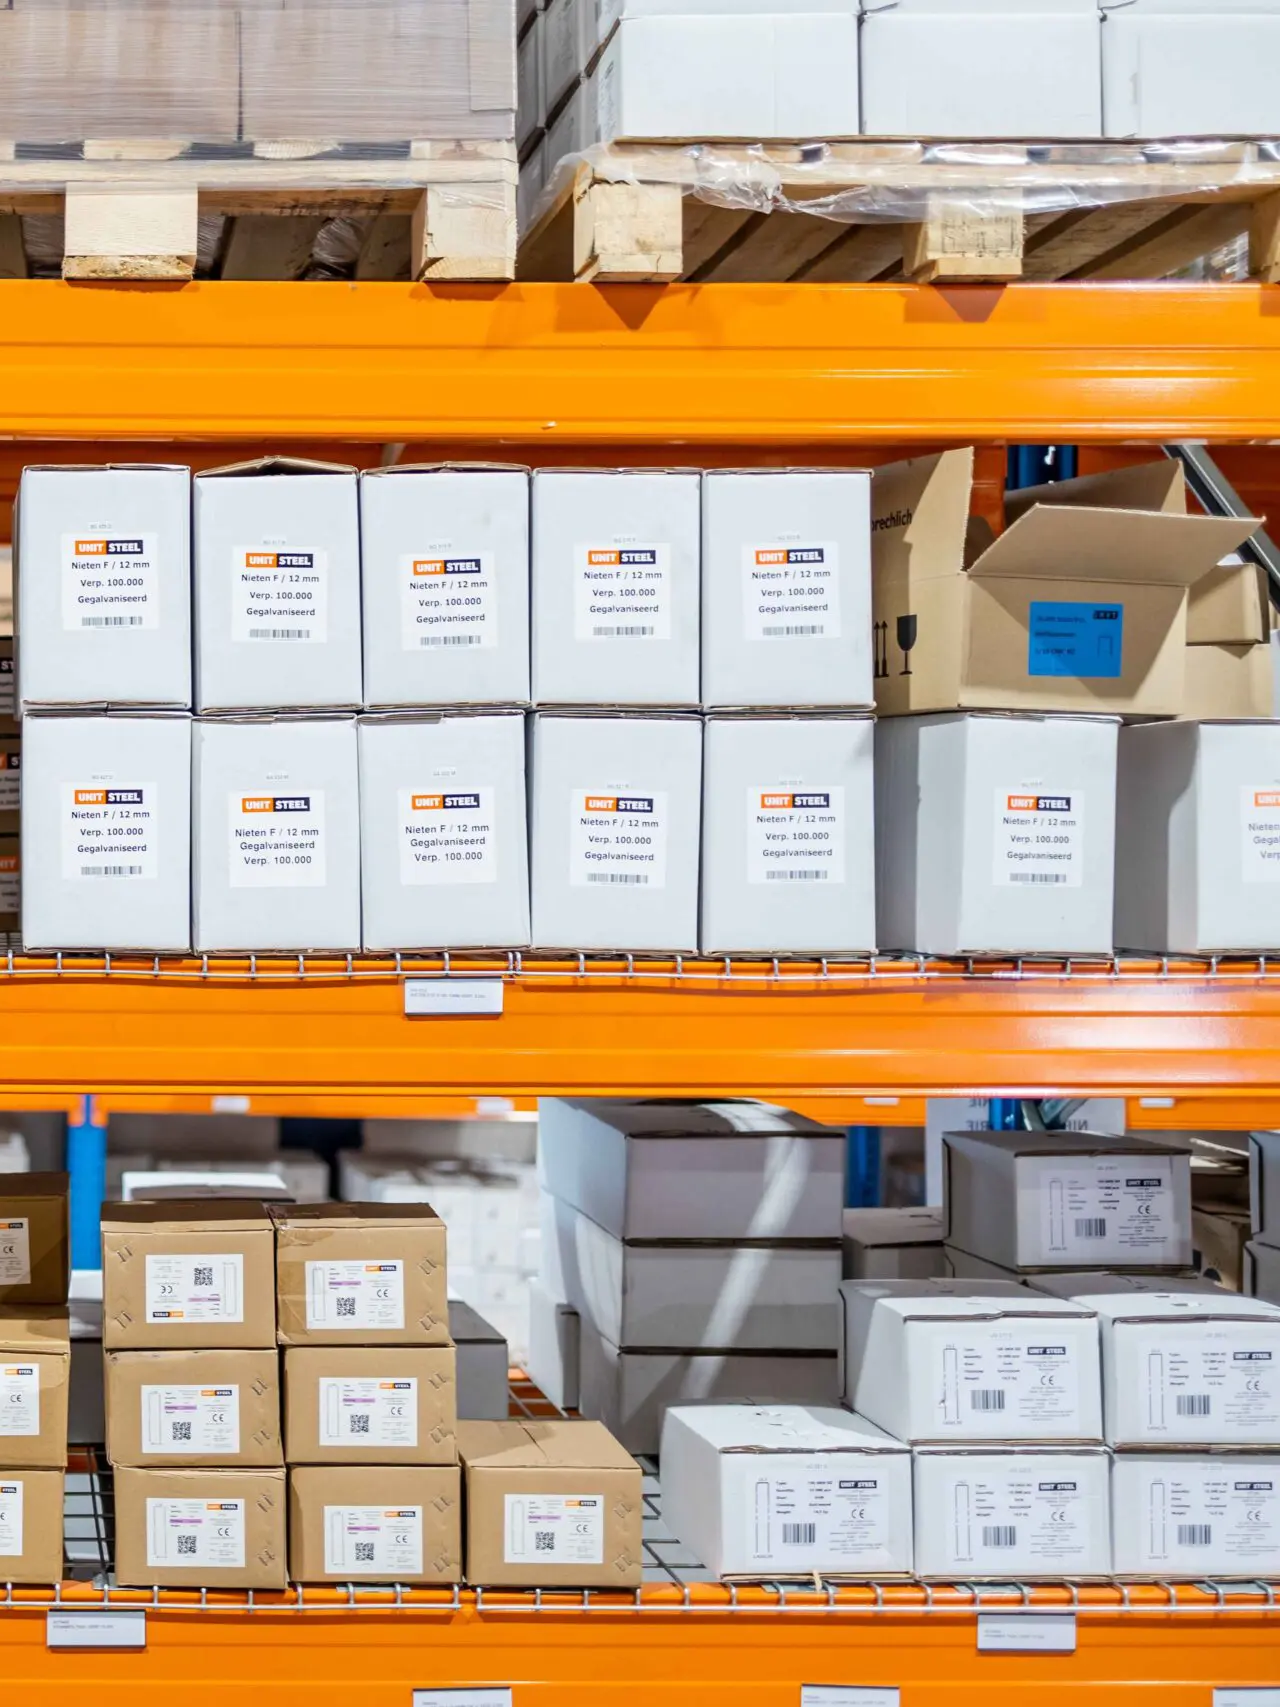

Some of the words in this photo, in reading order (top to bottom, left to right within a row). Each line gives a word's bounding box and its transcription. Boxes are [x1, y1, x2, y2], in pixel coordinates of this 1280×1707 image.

[79, 543, 103, 552] UNIT
[108, 542, 141, 552] STEEL
[249, 556, 274, 564] UNIT
[278, 556, 311, 565] STEEL
[591, 553, 616, 562] UNIT
[621, 552, 654, 562] STEEL
[759, 552, 784, 562] UNIT
[789, 551, 822, 561] STEEL
[71, 562, 101, 570] Nieten
[120, 561, 130, 569] 12
[416, 563, 441, 572] UNIT
[446, 561, 479, 572] STEEL
[80, 579, 104, 588] Verp.
[107, 578, 144, 587] 100.000
[289, 574, 300, 582] 12
[789, 587, 824, 596] 100.000
[77, 594, 147, 605] Gegalvaniseerd
[446, 597, 482, 606] 100.000
[246, 607, 315, 617] Gegalvaniseerd
[589, 605, 659, 614] Gegalvaniseerd
[758, 604, 828, 614] Gegalvaniseerd
[416, 614, 485, 624] Gegalvaniseerd
[78, 792, 103, 801] UNIT
[108, 792, 141, 802] STEEL
[415, 798, 440, 807] UNIT
[445, 796, 478, 806] STEEL
[764, 796, 790, 806] UNIT
[794, 796, 827, 806] STEEL
[245, 801, 270, 810] UNIT
[275, 800, 308, 809] STEEL
[589, 799, 613, 808] UNIT
[618, 800, 651, 810] STEEL
[1011, 798, 1034, 808] UNIT
[1038, 799, 1068, 809] STEEL
[120, 810, 130, 818] 12
[80, 829, 104, 837] Verp.
[107, 828, 143, 836] 100.000
[410, 837, 485, 849] Gegalvaniseerd
[588, 836, 611, 844] Verp.
[616, 836, 651, 844] 100.000
[77, 844, 147, 854] Gegalvaniseerd
[240, 841, 315, 852] Gegalvaniseerd
[414, 853, 440, 863] Verp.
[445, 852, 482, 861] 100.000
[585, 851, 654, 861] Gegalvaniseerd
[762, 849, 832, 858] Gegalvaniseerd
[1007, 851, 1072, 860] Gegalvaniseerd
